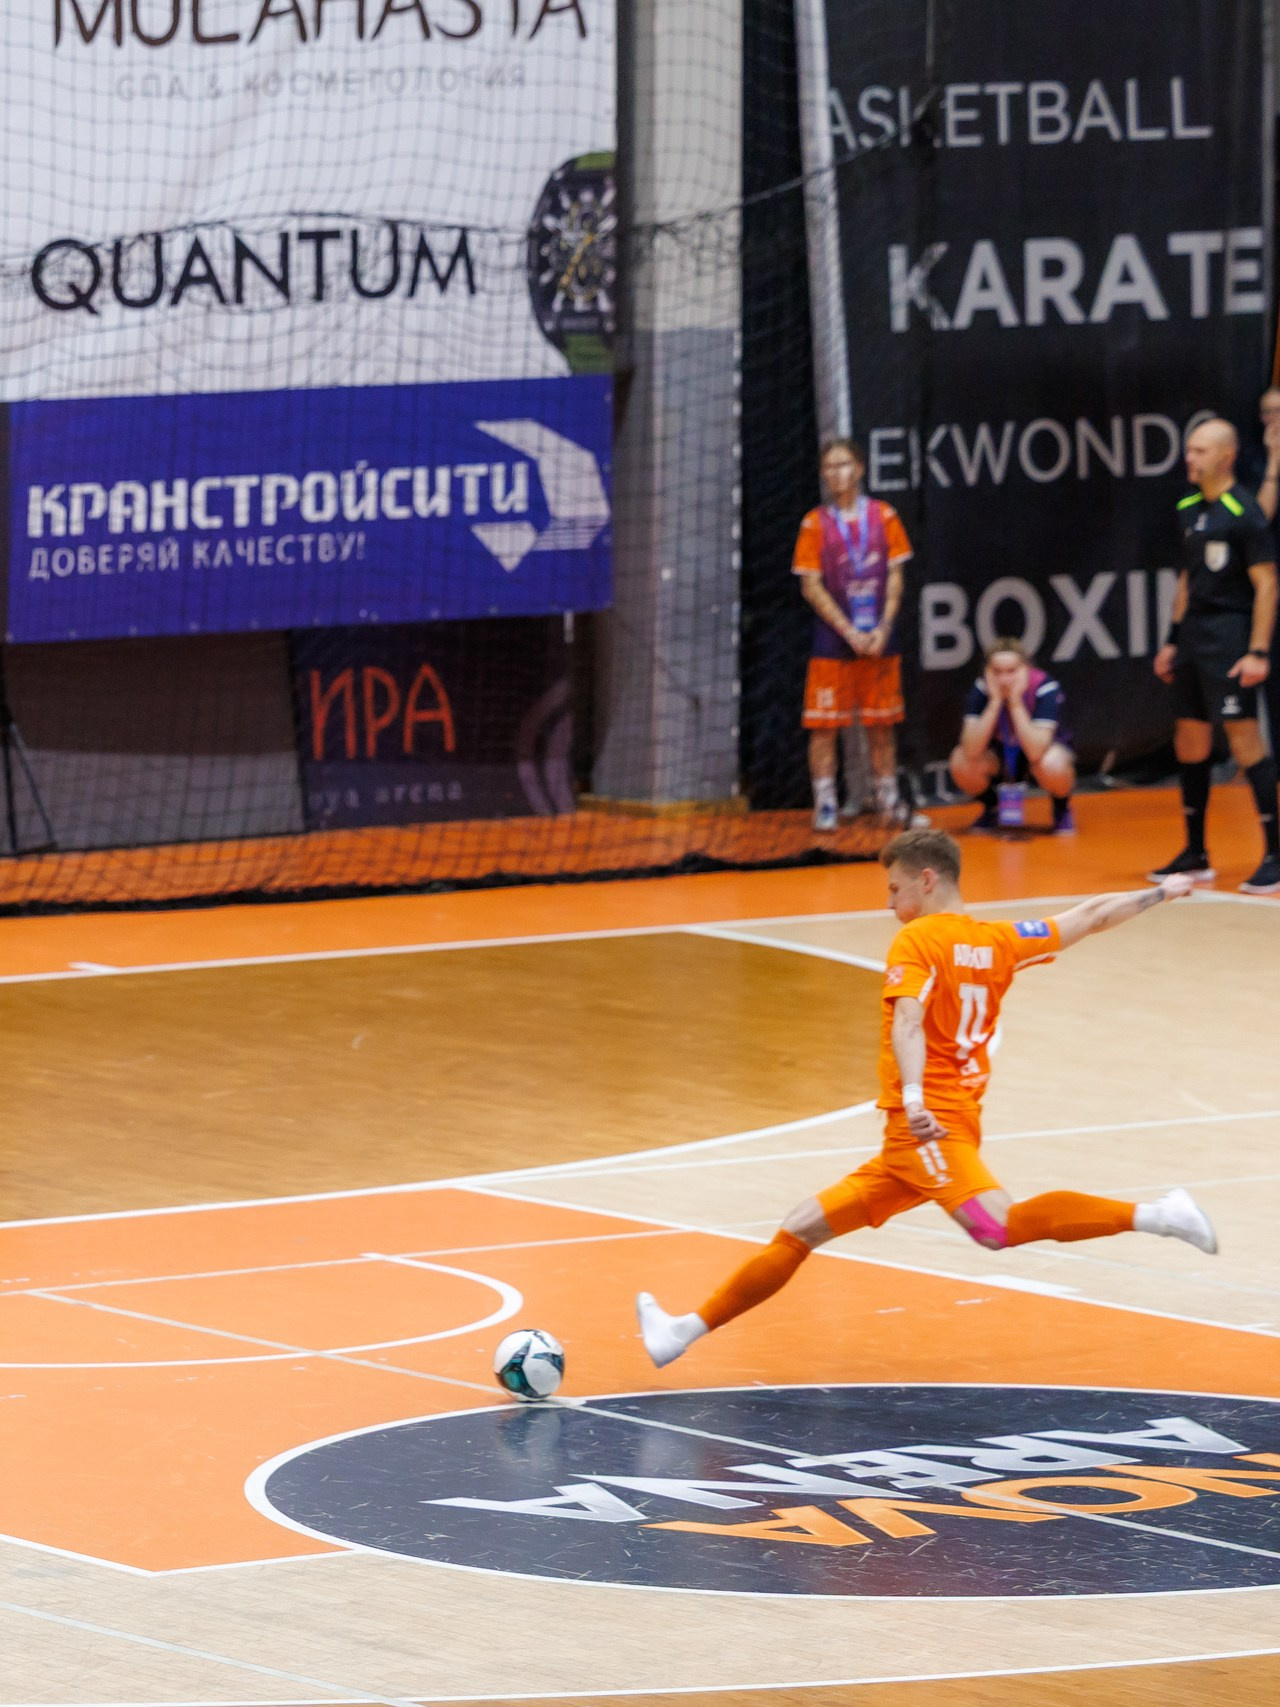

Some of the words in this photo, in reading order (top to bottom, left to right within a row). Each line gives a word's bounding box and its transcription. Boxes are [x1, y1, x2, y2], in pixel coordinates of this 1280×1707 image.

[31, 221, 476, 315] QUANTUM
[887, 227, 1268, 333] KARATE
[27, 460, 528, 538] КРАНСТРОЙСИТИ
[28, 538, 180, 582] ДОВЕРЯЙ
[192, 531, 367, 570] КАЧЕСТВУ!
[418, 1416, 1251, 1523] ARENA
[640, 1452, 1280, 1547] NOVA
